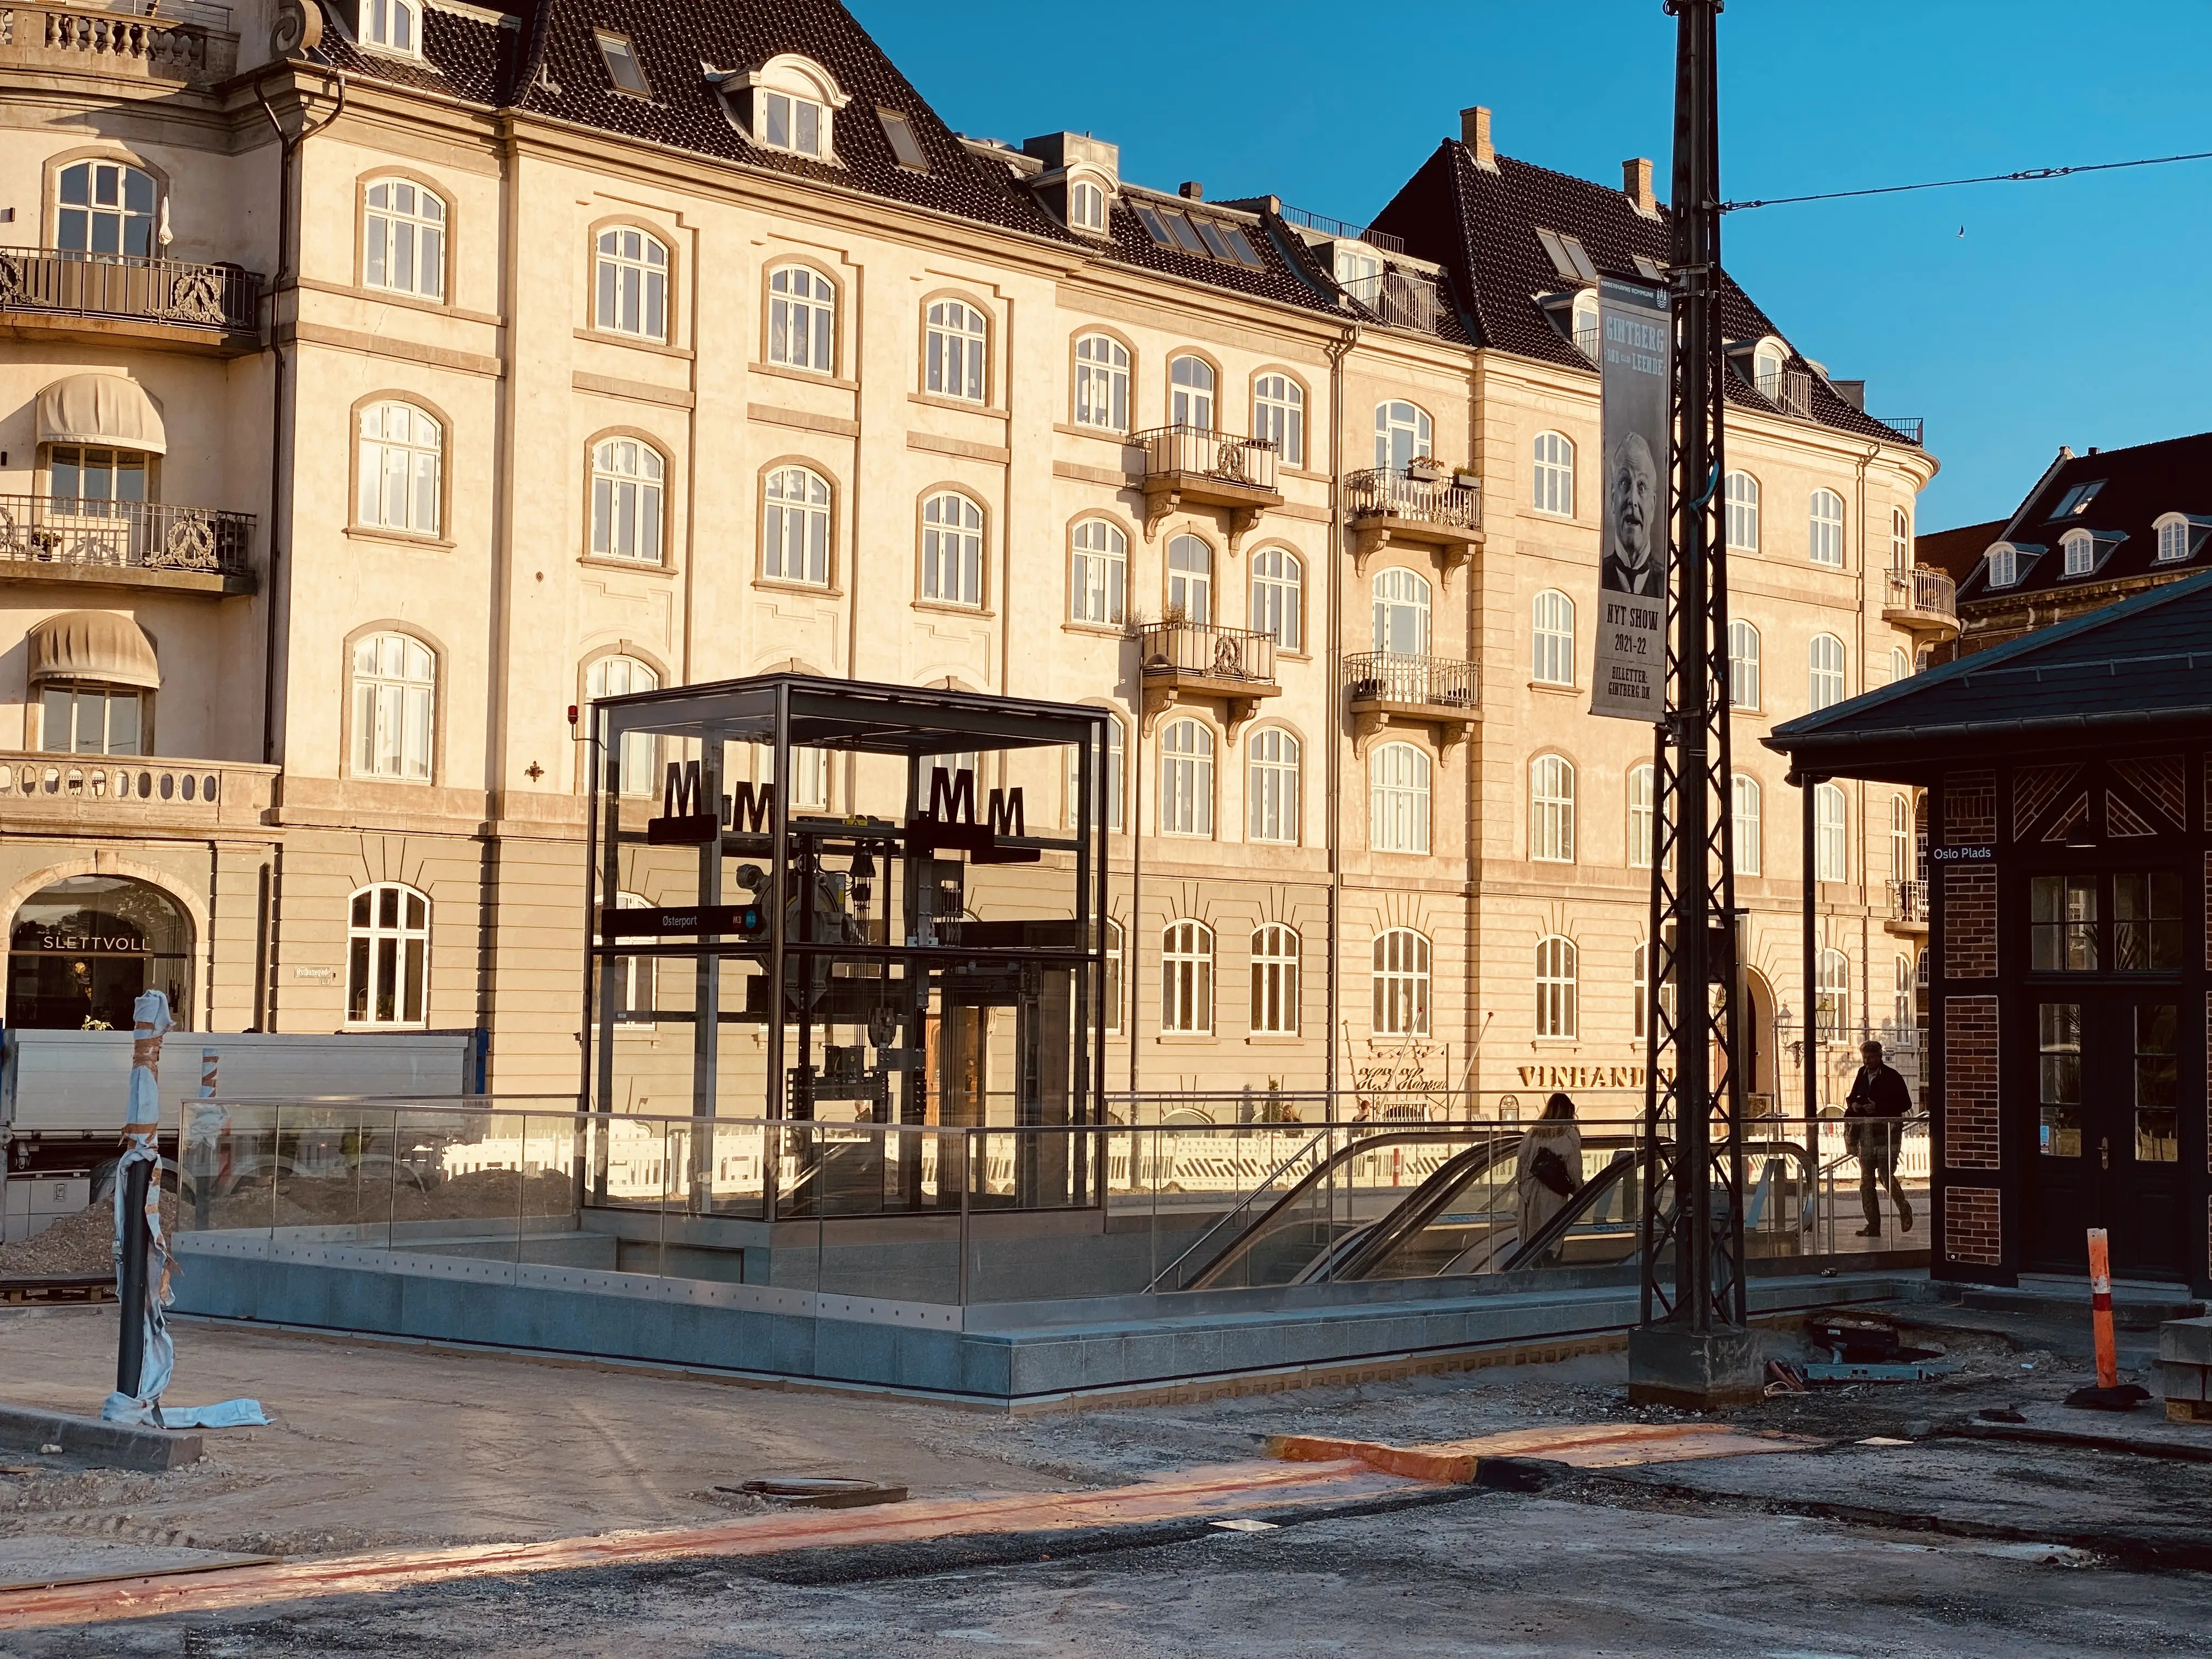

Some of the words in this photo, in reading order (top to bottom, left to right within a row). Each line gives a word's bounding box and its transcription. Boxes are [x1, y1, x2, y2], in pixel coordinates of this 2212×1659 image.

[1600, 280, 1630, 293] KØBENHAVNS
[1631, 287, 1654, 298] KOMMUNE
[1606, 315, 1664, 353] GINTBERG
[1632, 353, 1663, 376] LEENDE
[1607, 603, 1627, 625] NYT
[1630, 608, 1659, 631] SHOW
[1615, 634, 1646, 654] 2021-22
[1612, 666, 1648, 684] BILLETTER:
[1609, 682, 1651, 699] GINTBERG.DK
[664, 760, 702, 818] M
[929, 766, 975, 825] M
[988, 787, 1025, 837] M
[1934, 848, 1959, 860] Oslo
[1961, 847, 1991, 858] Plads
[662, 916, 697, 928] Østerport
[732, 916, 742, 924] M3
[43, 936, 151, 950] SLETTVOLL
[1517, 1066, 1677, 1088] VINHAND
